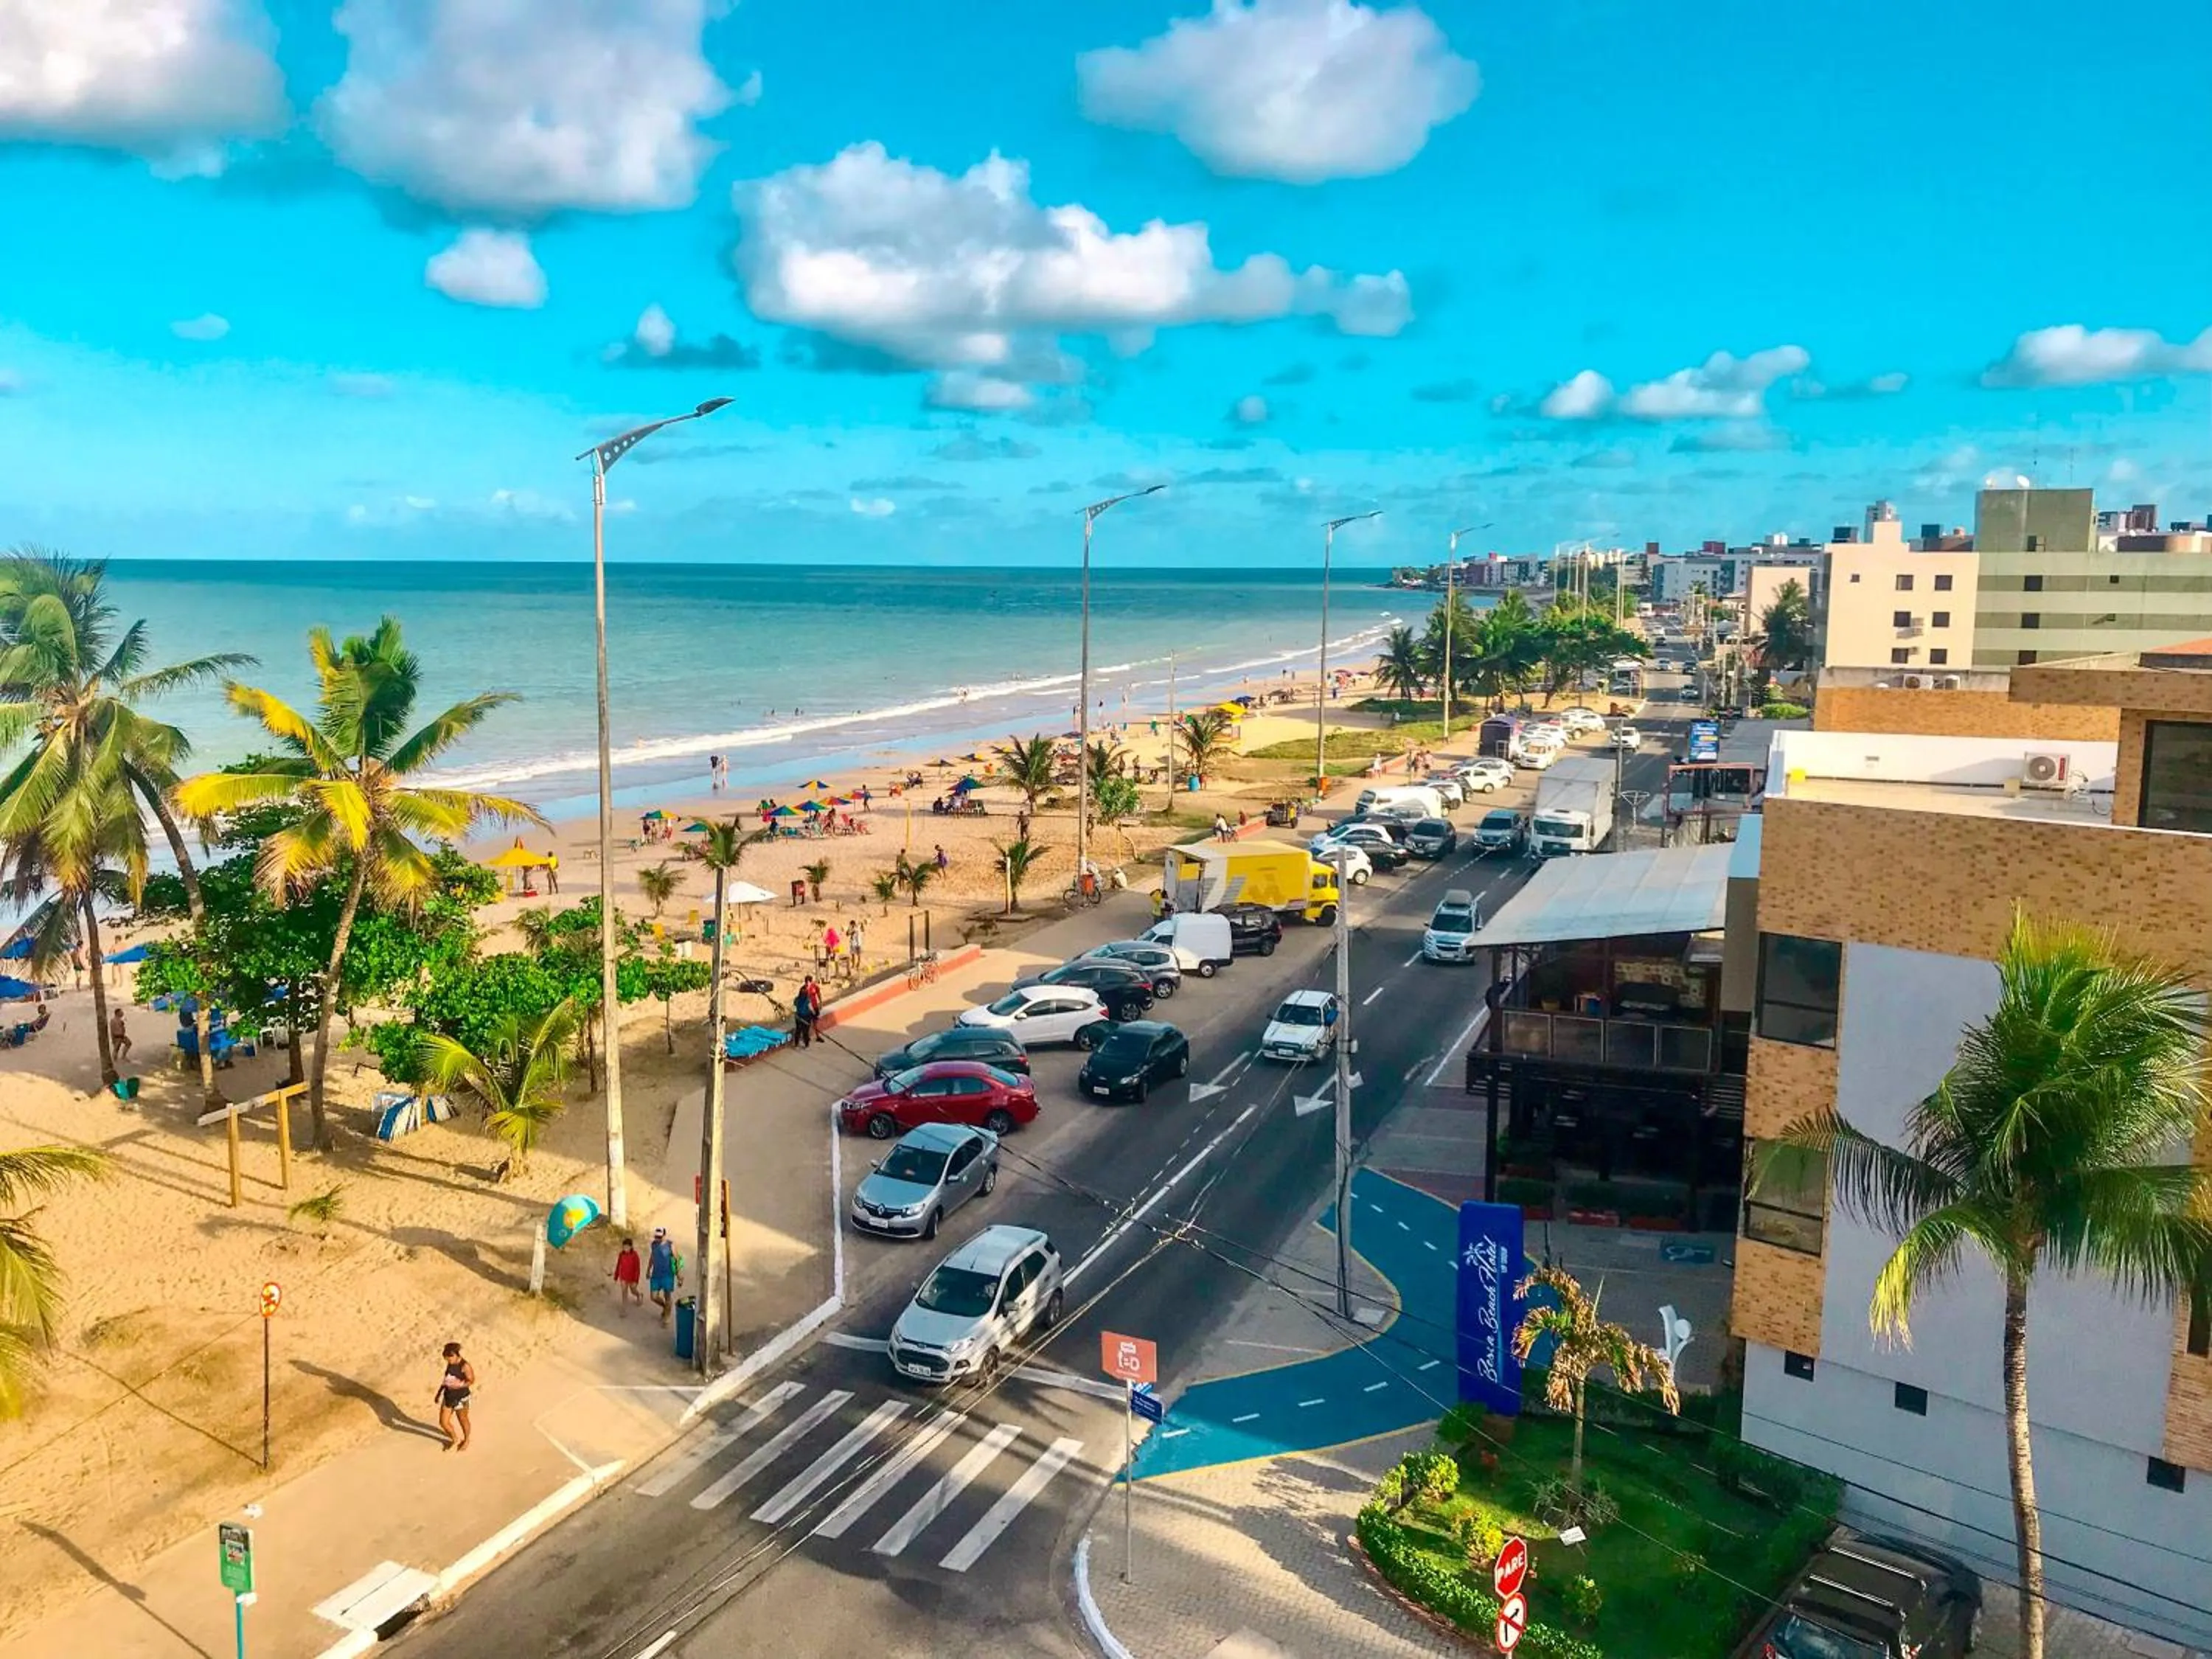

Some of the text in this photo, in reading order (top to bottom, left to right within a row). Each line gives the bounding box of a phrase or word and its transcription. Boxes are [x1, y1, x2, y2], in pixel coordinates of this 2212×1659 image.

[1479, 1234, 1497, 1284] Hotel
[1478, 1283, 1498, 1334] Beach
[1498, 1551, 1524, 1584] PARE
